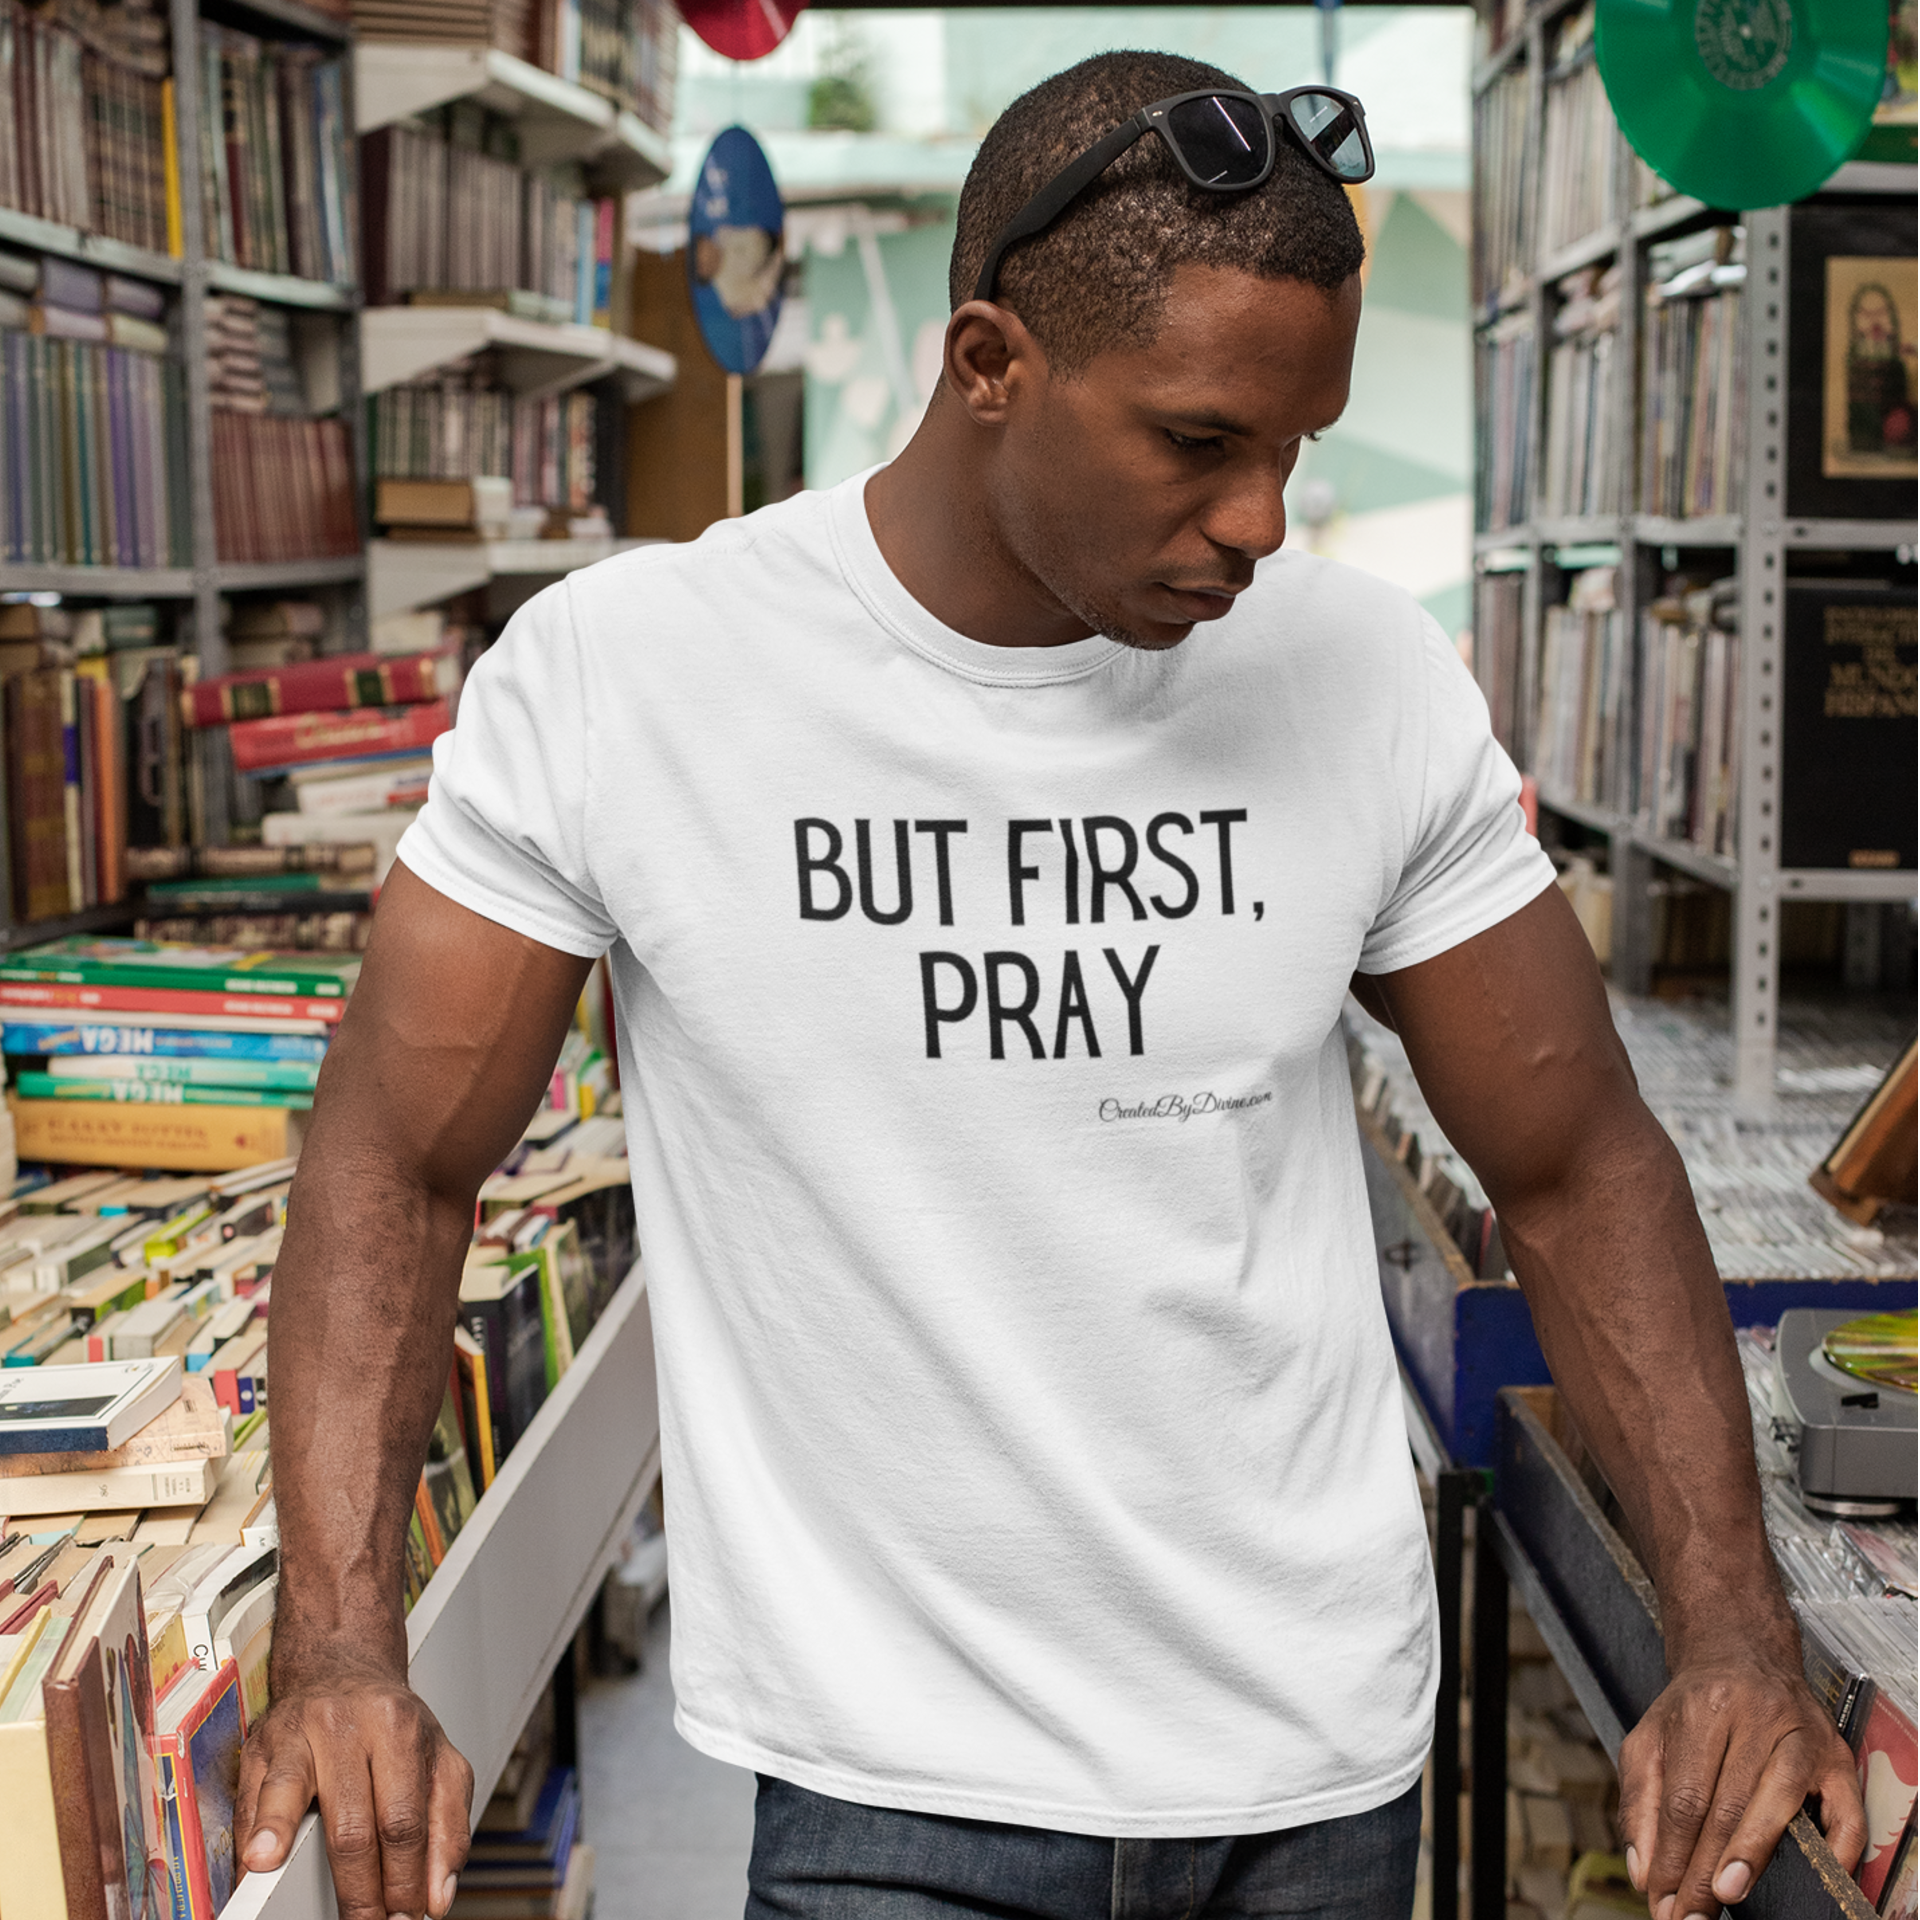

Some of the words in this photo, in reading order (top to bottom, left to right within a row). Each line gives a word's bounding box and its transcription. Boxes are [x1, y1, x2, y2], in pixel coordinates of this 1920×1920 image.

[794, 817, 967, 926] BUT
[1008, 808, 1264, 926] FIRST,
[919, 944, 1161, 1060] PRAY
[81, 1027, 154, 1053] MEGA
[112, 1081, 184, 1103] MEGA
